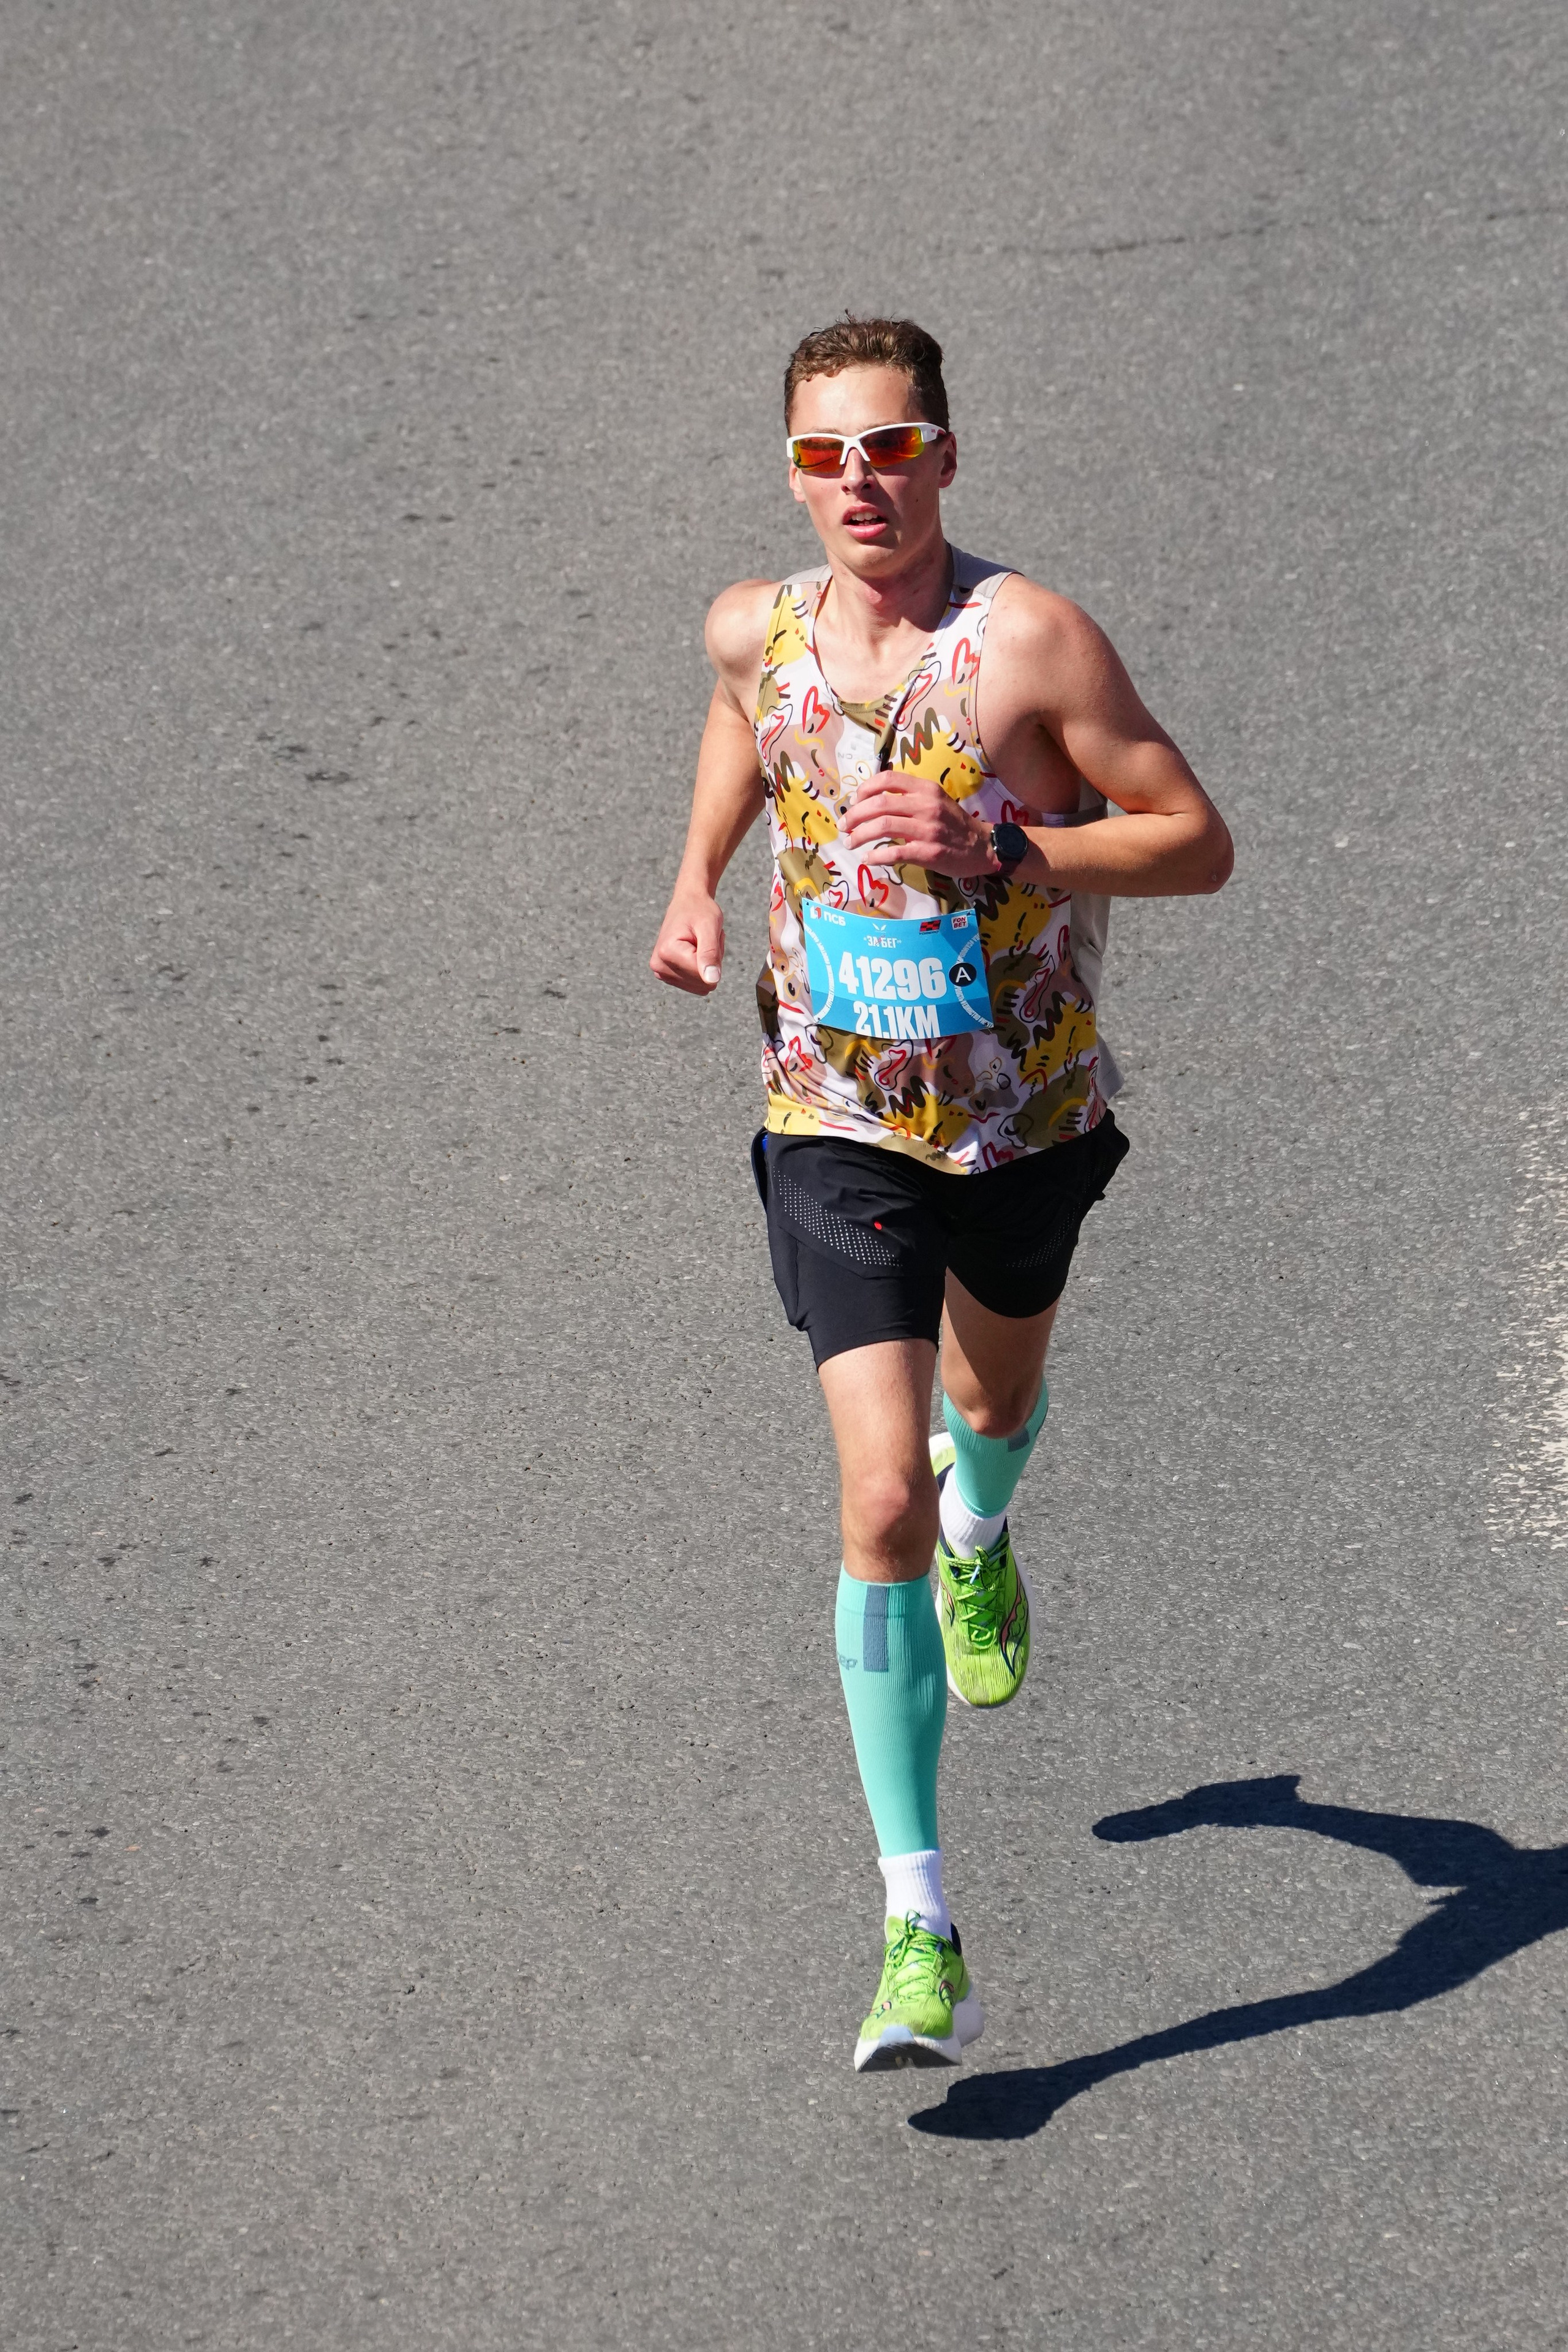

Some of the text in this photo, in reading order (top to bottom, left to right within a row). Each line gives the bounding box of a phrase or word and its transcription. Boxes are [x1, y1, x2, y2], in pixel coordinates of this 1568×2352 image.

[823, 911, 846, 927] ПСБ
[839, 951, 947, 1001] 41296
[955, 967, 971, 983] A
